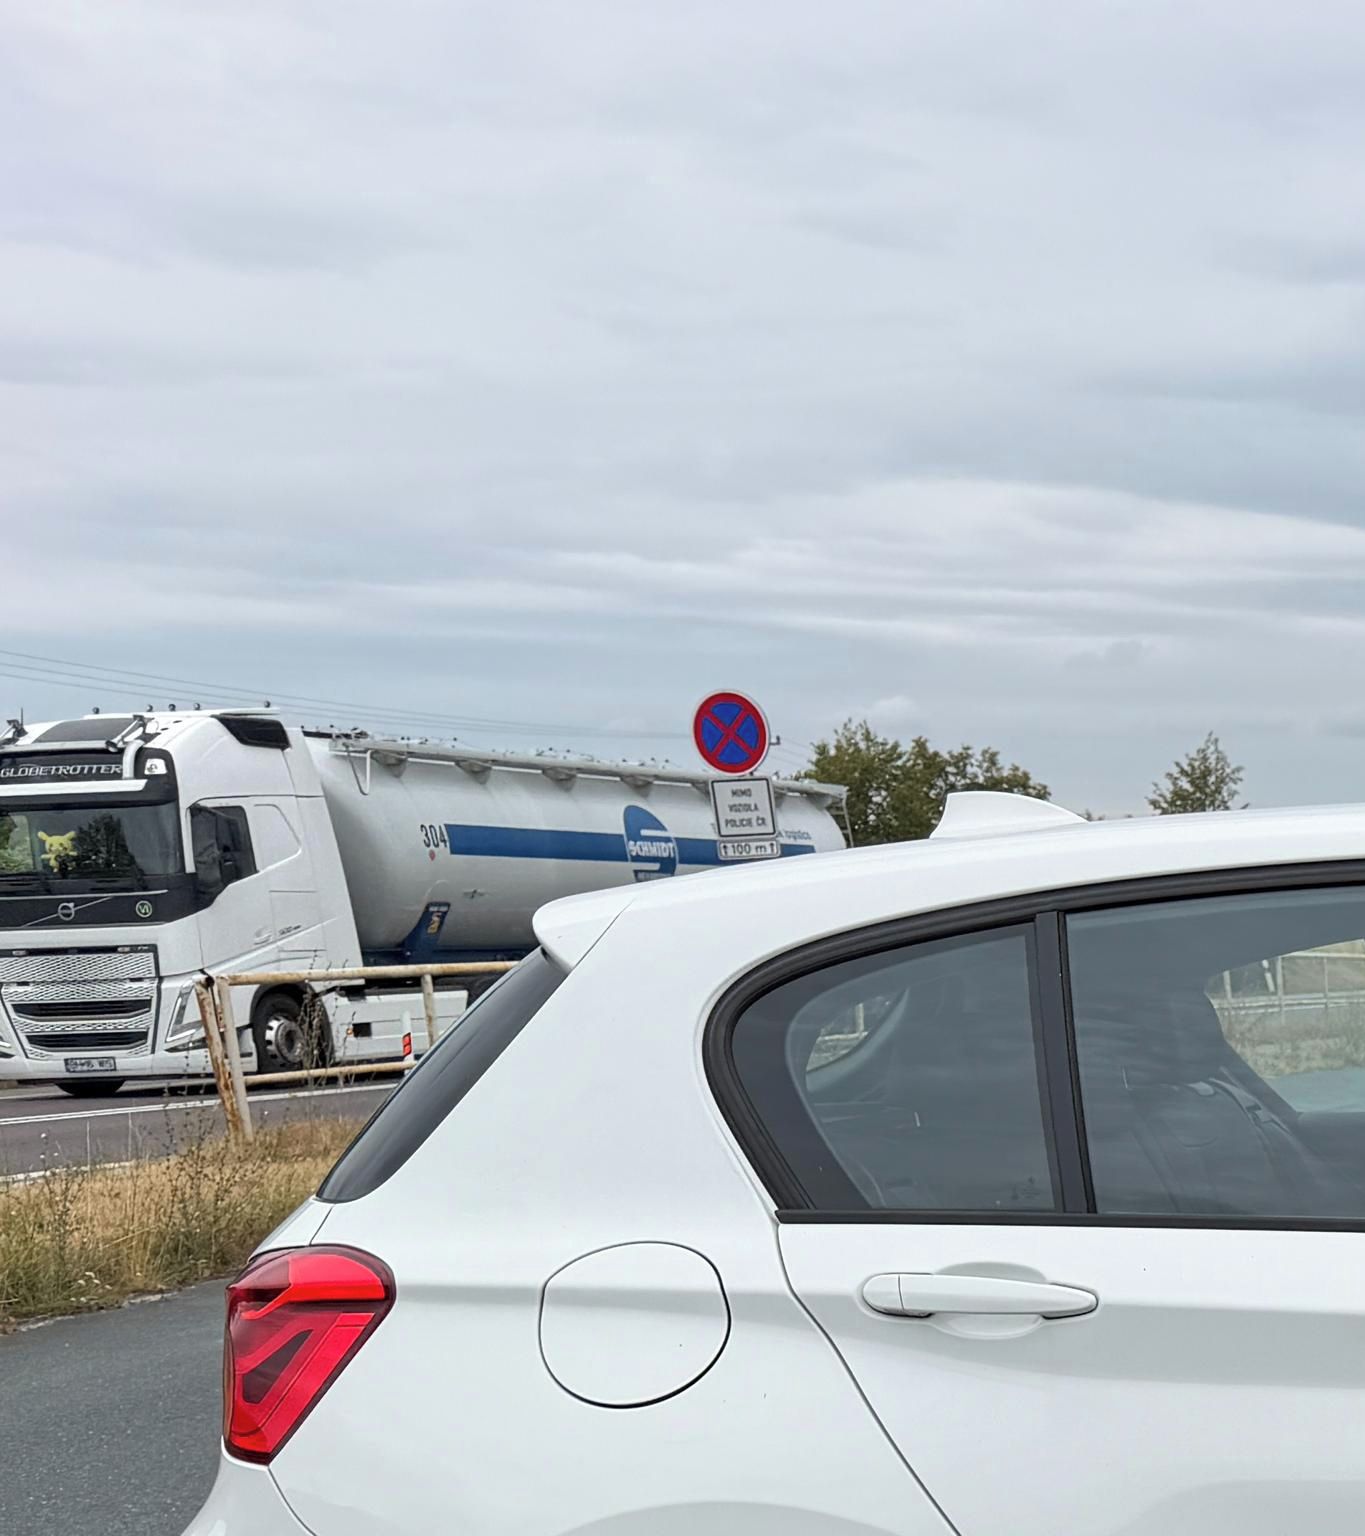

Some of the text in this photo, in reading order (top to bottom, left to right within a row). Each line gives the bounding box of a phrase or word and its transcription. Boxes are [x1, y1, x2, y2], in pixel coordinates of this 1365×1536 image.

[0, 764, 122, 778] GLOBETROTTER
[731, 788, 752, 797] MIMO
[725, 818, 753, 828] POLICIE
[420, 824, 447, 848] 304
[628, 840, 675, 858] SCHMIDT
[731, 844, 751, 855] 100
